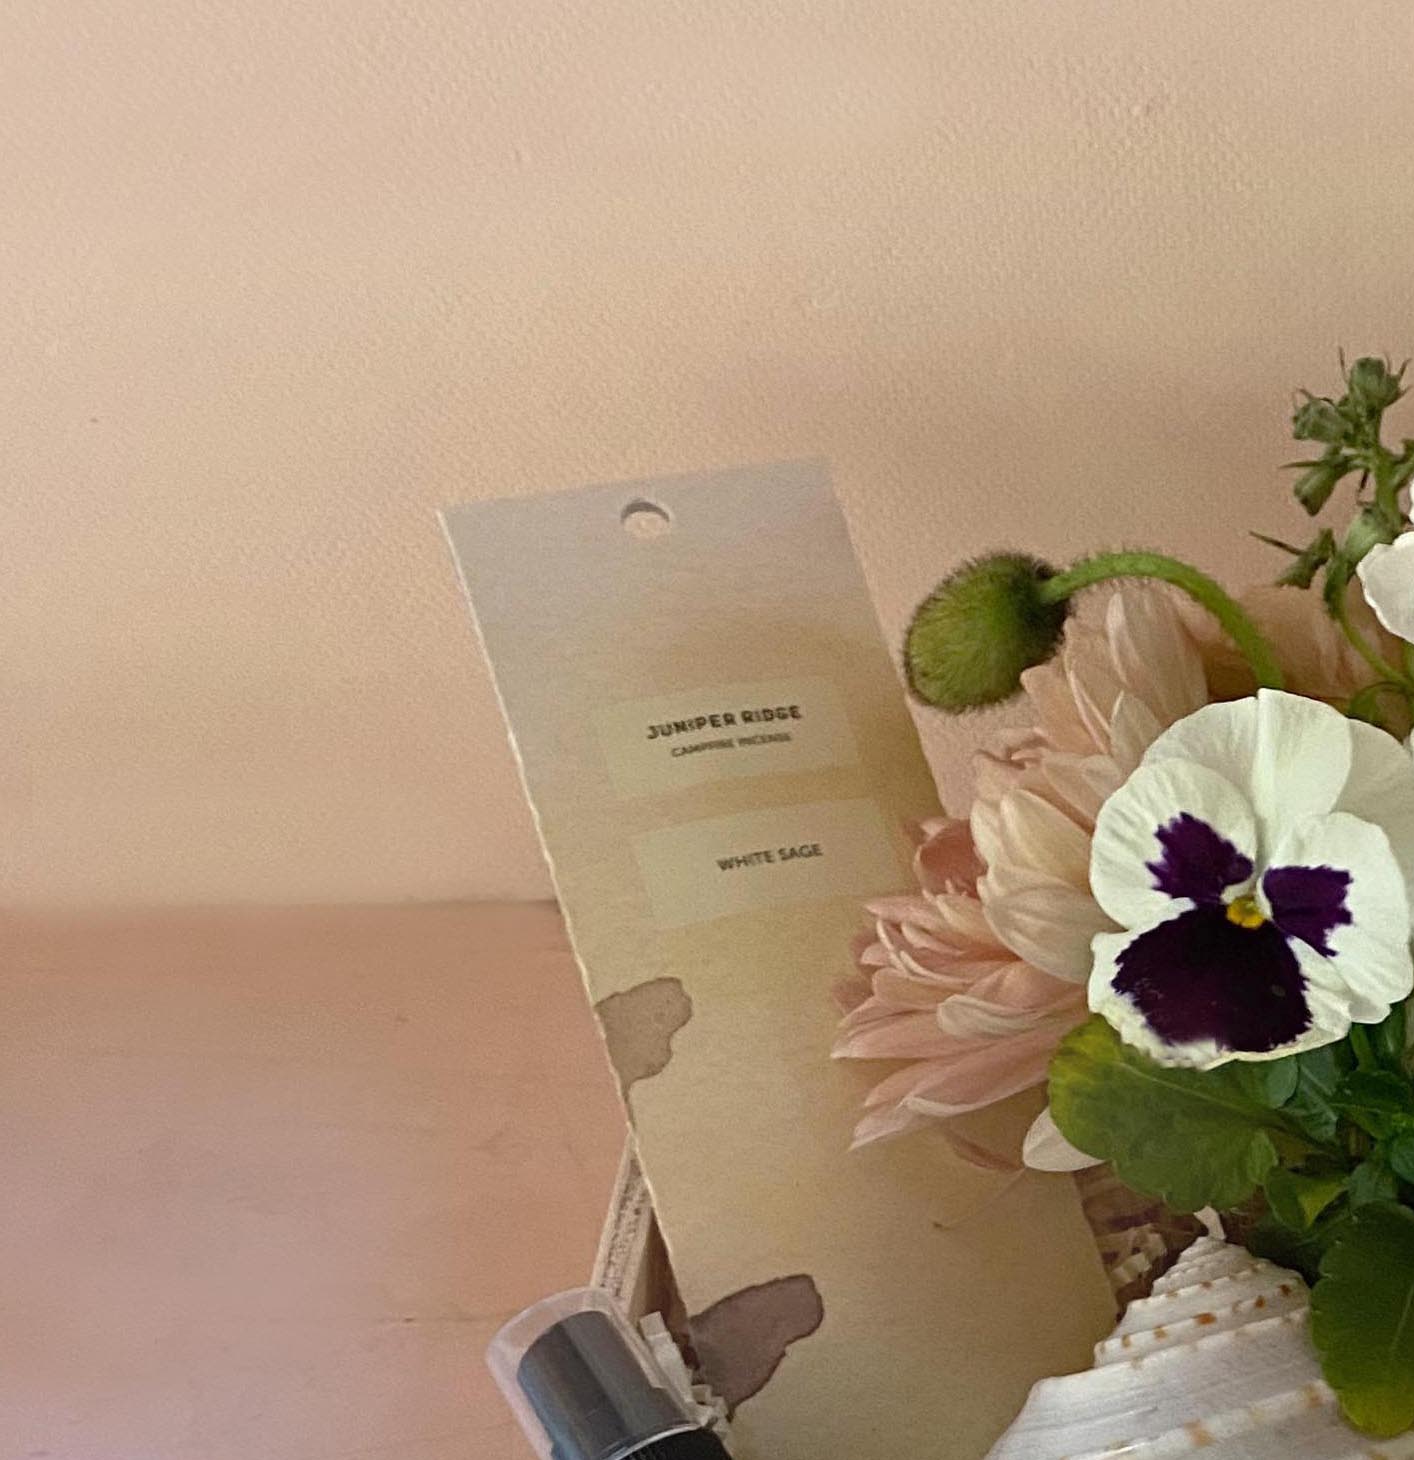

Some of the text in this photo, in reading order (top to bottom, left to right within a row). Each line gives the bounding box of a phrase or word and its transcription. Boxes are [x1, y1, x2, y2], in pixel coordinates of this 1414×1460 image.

[647, 705, 803, 740] JUNIPER RIDGE
[716, 843, 823, 872] WHITE SAGE
